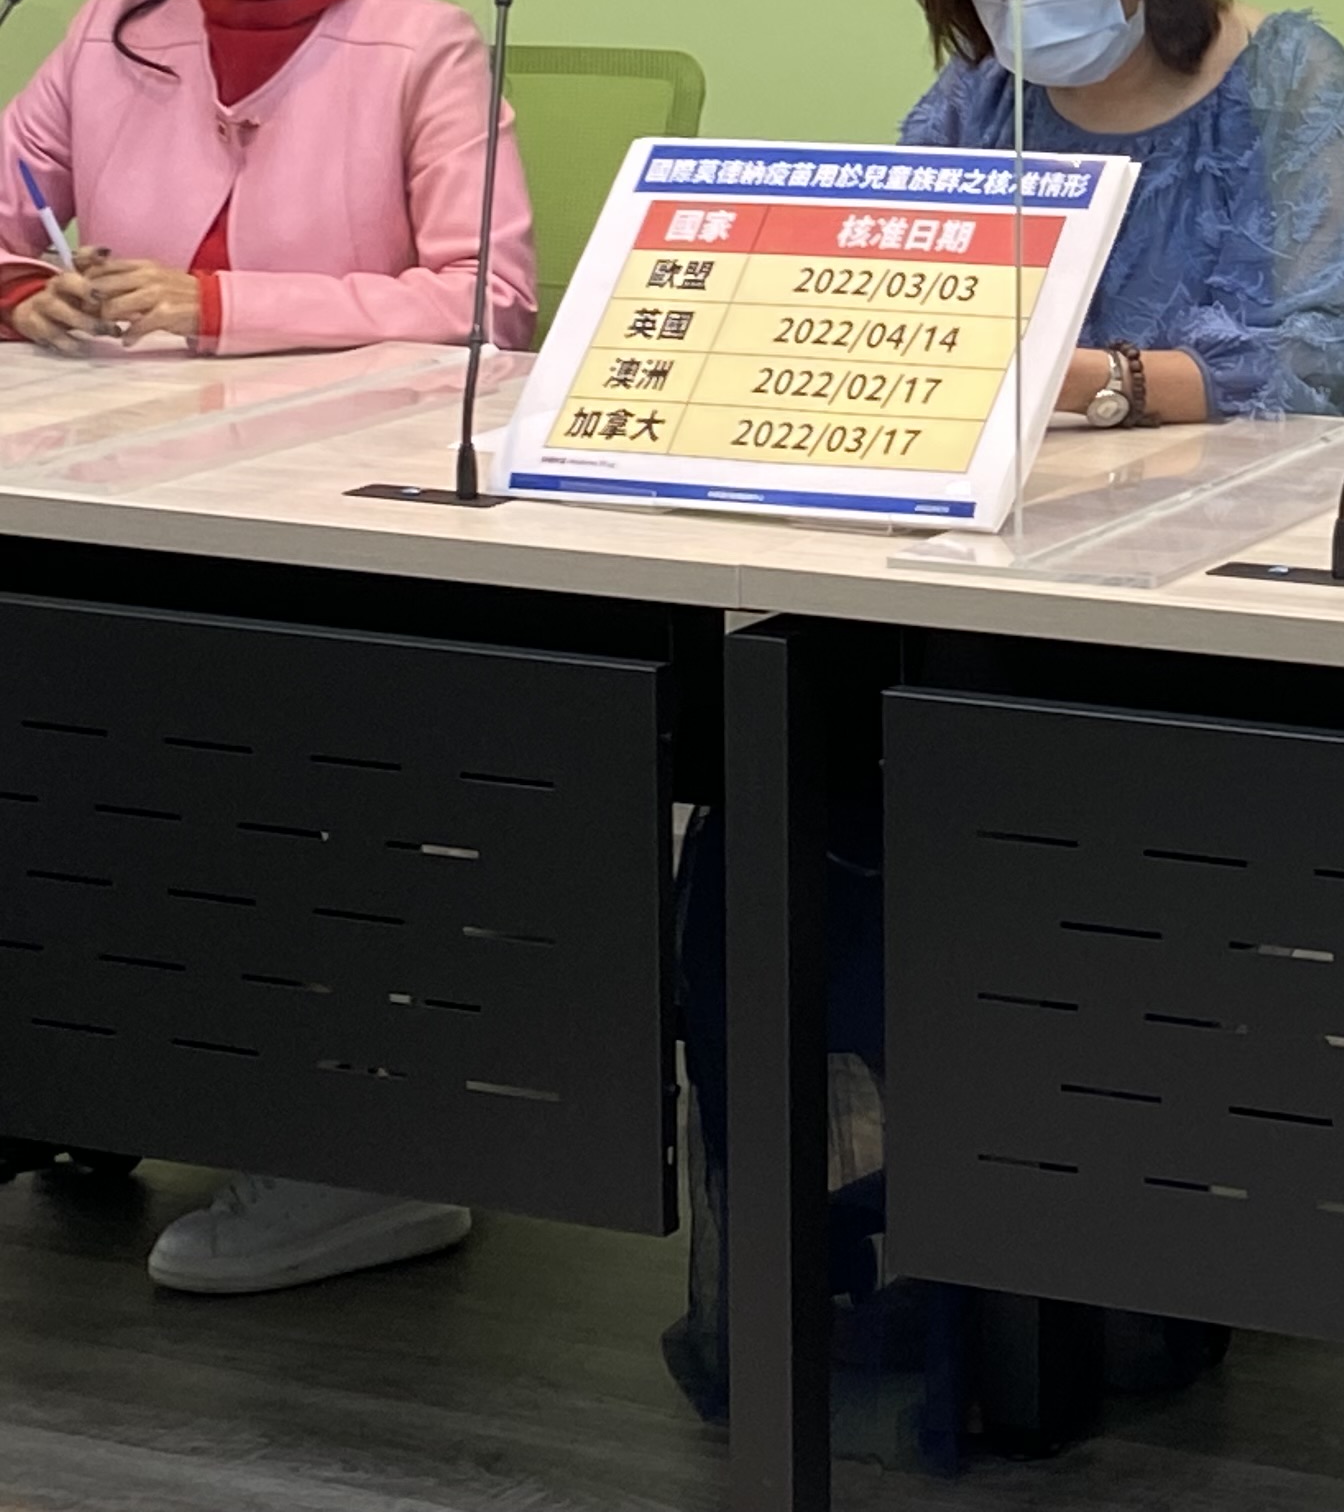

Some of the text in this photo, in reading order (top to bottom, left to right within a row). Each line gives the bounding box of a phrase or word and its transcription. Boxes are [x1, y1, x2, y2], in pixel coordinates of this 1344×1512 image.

[664, 209, 736, 243] 國家
[836, 214, 976, 254] 核准日期
[646, 258, 715, 291] 歐盟
[793, 266, 980, 302] 2022/03/03
[625, 308, 696, 341] 英國
[772, 316, 960, 355] 2022/04/14
[602, 356, 675, 392] 澳洲
[751, 367, 943, 406] 2022/02/17
[563, 407, 666, 442] 加拿大
[730, 418, 923, 458] 2022/03/17
